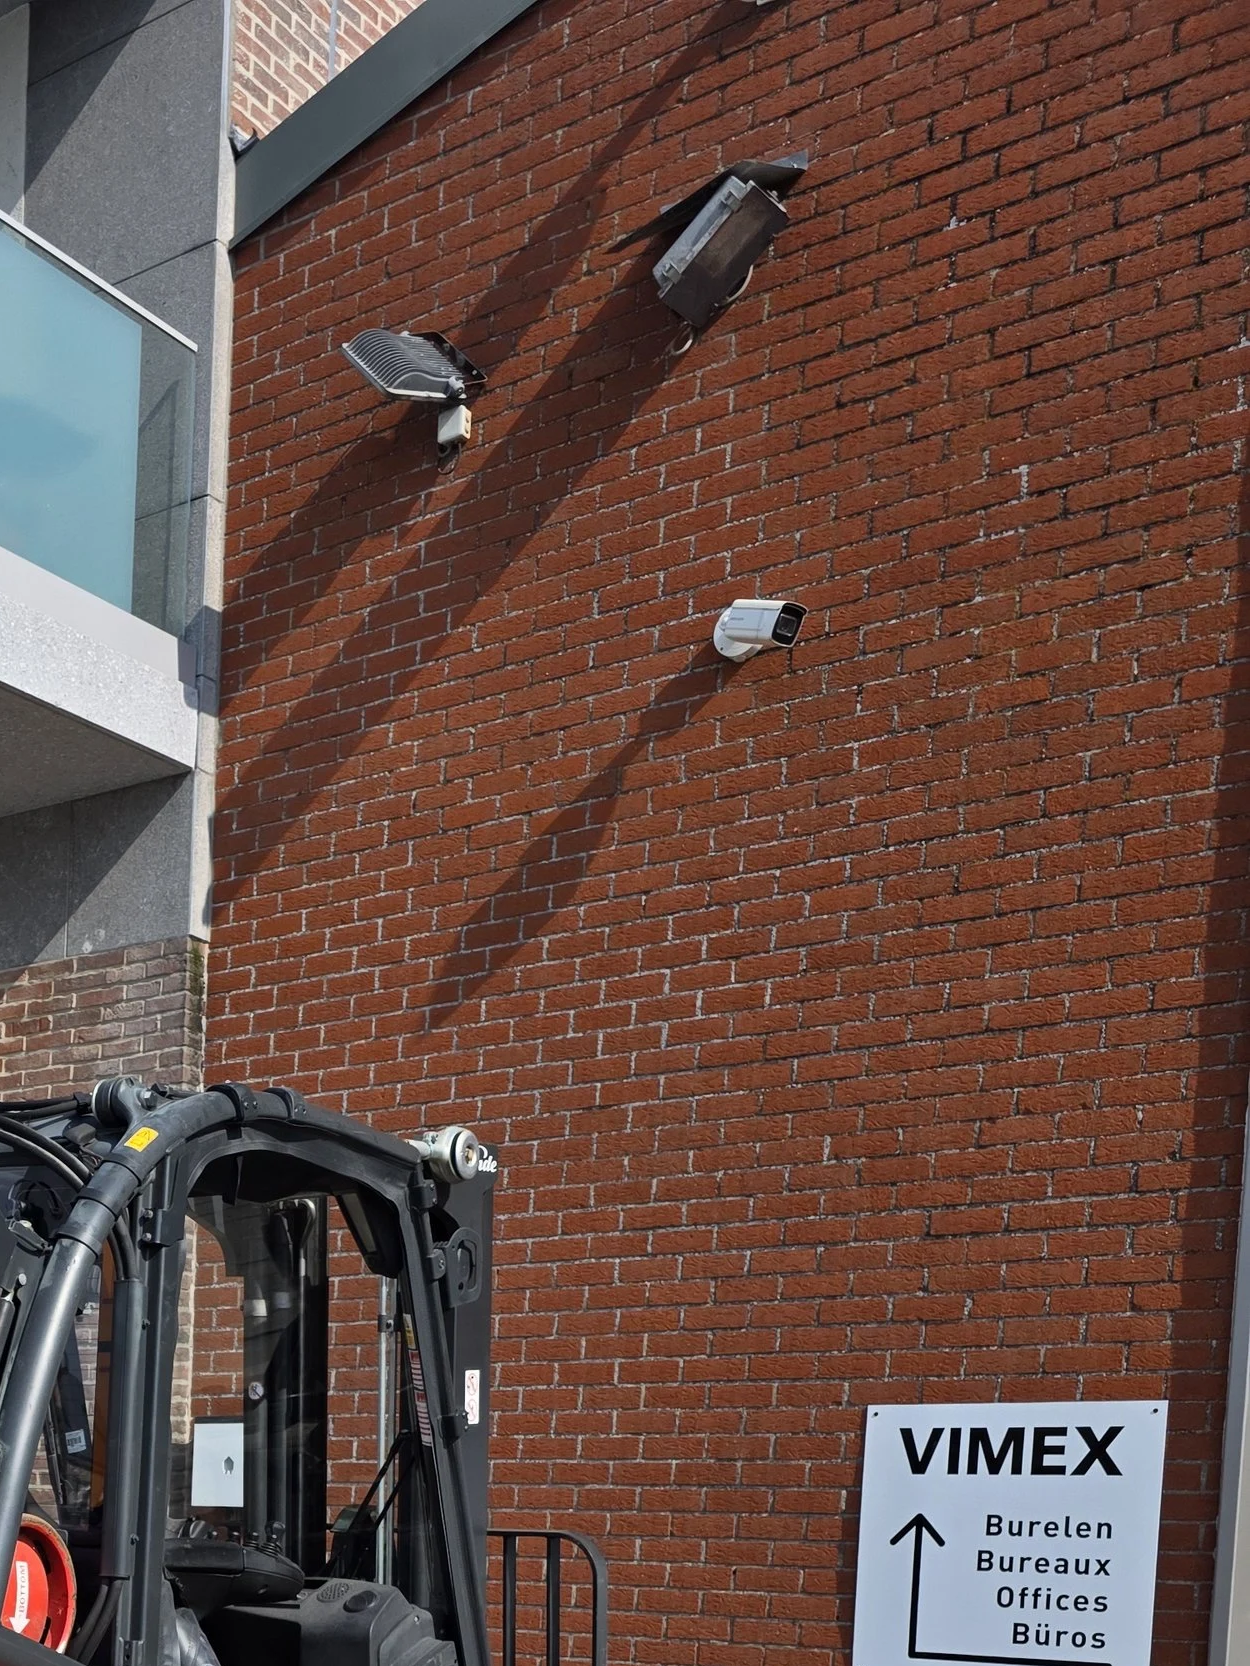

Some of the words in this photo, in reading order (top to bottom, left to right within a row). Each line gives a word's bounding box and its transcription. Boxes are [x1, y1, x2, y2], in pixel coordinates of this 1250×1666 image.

[899, 1425, 1125, 1477] VIMEX
[985, 1513, 1113, 1540] Burelen
[976, 1549, 1111, 1577] Bureaux
[18, 1564, 27, 1613] BOTTOM
[996, 1586, 1109, 1613] Offices
[1011, 1622, 1106, 1650] Büros
